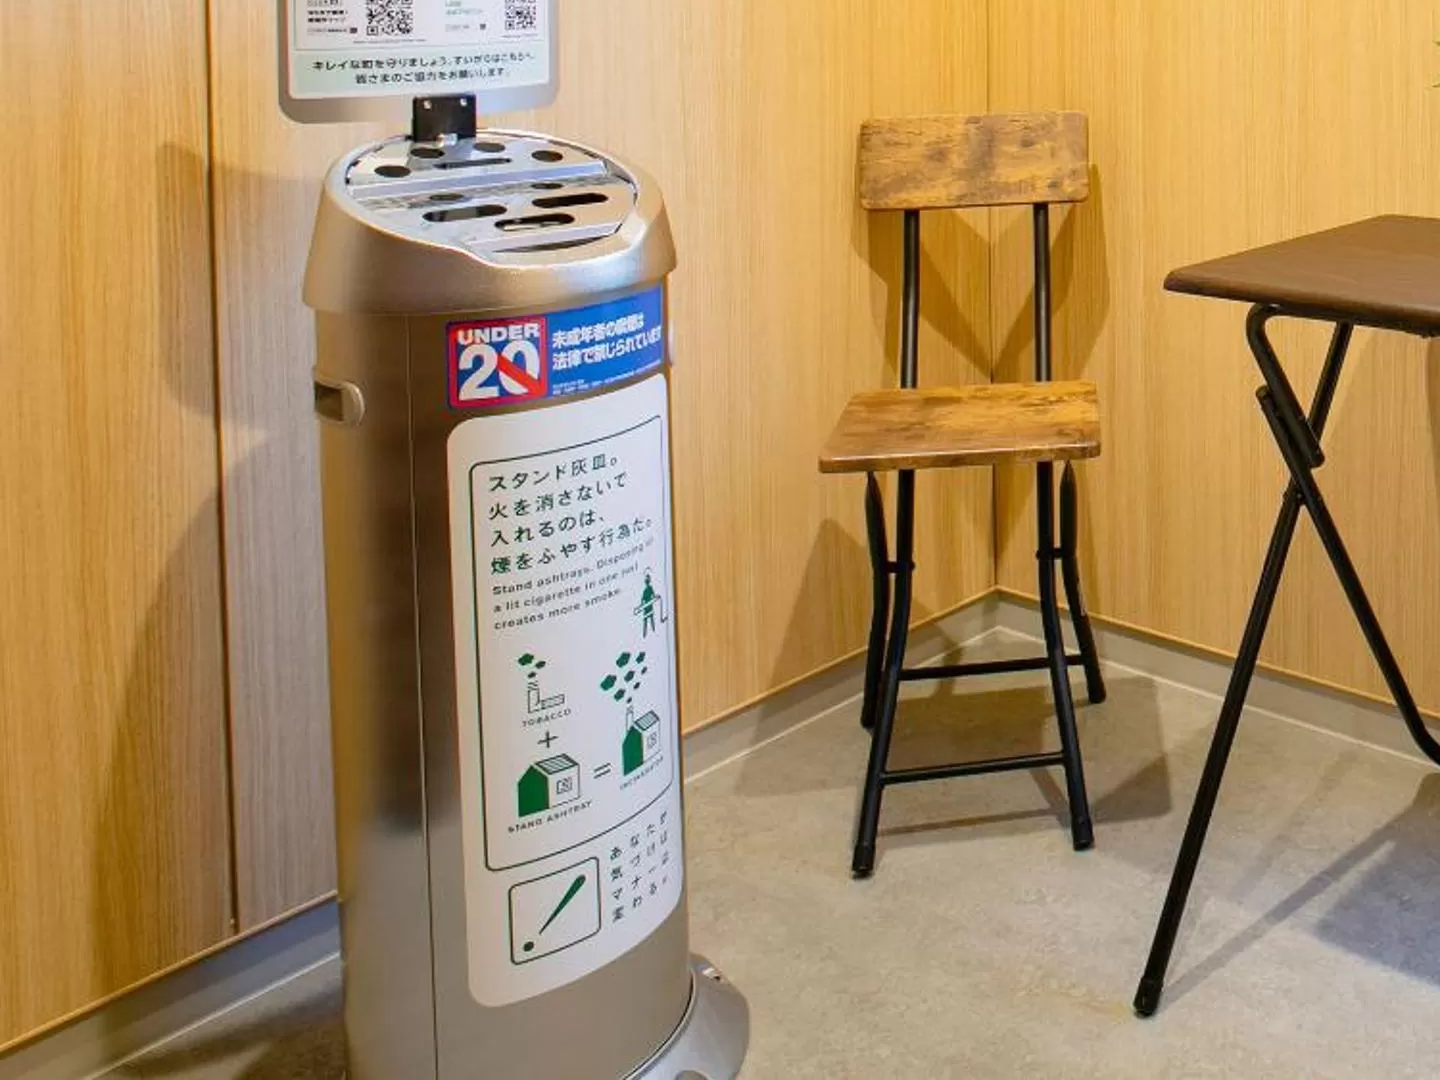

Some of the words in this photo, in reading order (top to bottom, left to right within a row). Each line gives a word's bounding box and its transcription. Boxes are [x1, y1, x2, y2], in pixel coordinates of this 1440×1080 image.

[457, 322, 541, 345] UNDER
[552, 326, 663, 371] 法律で禁じられています
[457, 339, 541, 401] 20
[489, 453, 618, 492] スタンド灰皿。
[488, 471, 628, 520] 火を消さないで
[490, 508, 605, 548] 入れるのは、
[490, 517, 652, 576] 煙をふやす行為だ。
[492, 579, 533, 595] Stand
[493, 604, 502, 613] a
[506, 599, 520, 611] lit
[523, 584, 581, 607] cigarette
[585, 578, 597, 591] in
[494, 612, 545, 630] creates
[548, 603, 581, 618] more
[522, 708, 572, 728] TOBACCO
[507, 818, 543, 834] STAND
[546, 800, 593, 823] ASHTRAY
